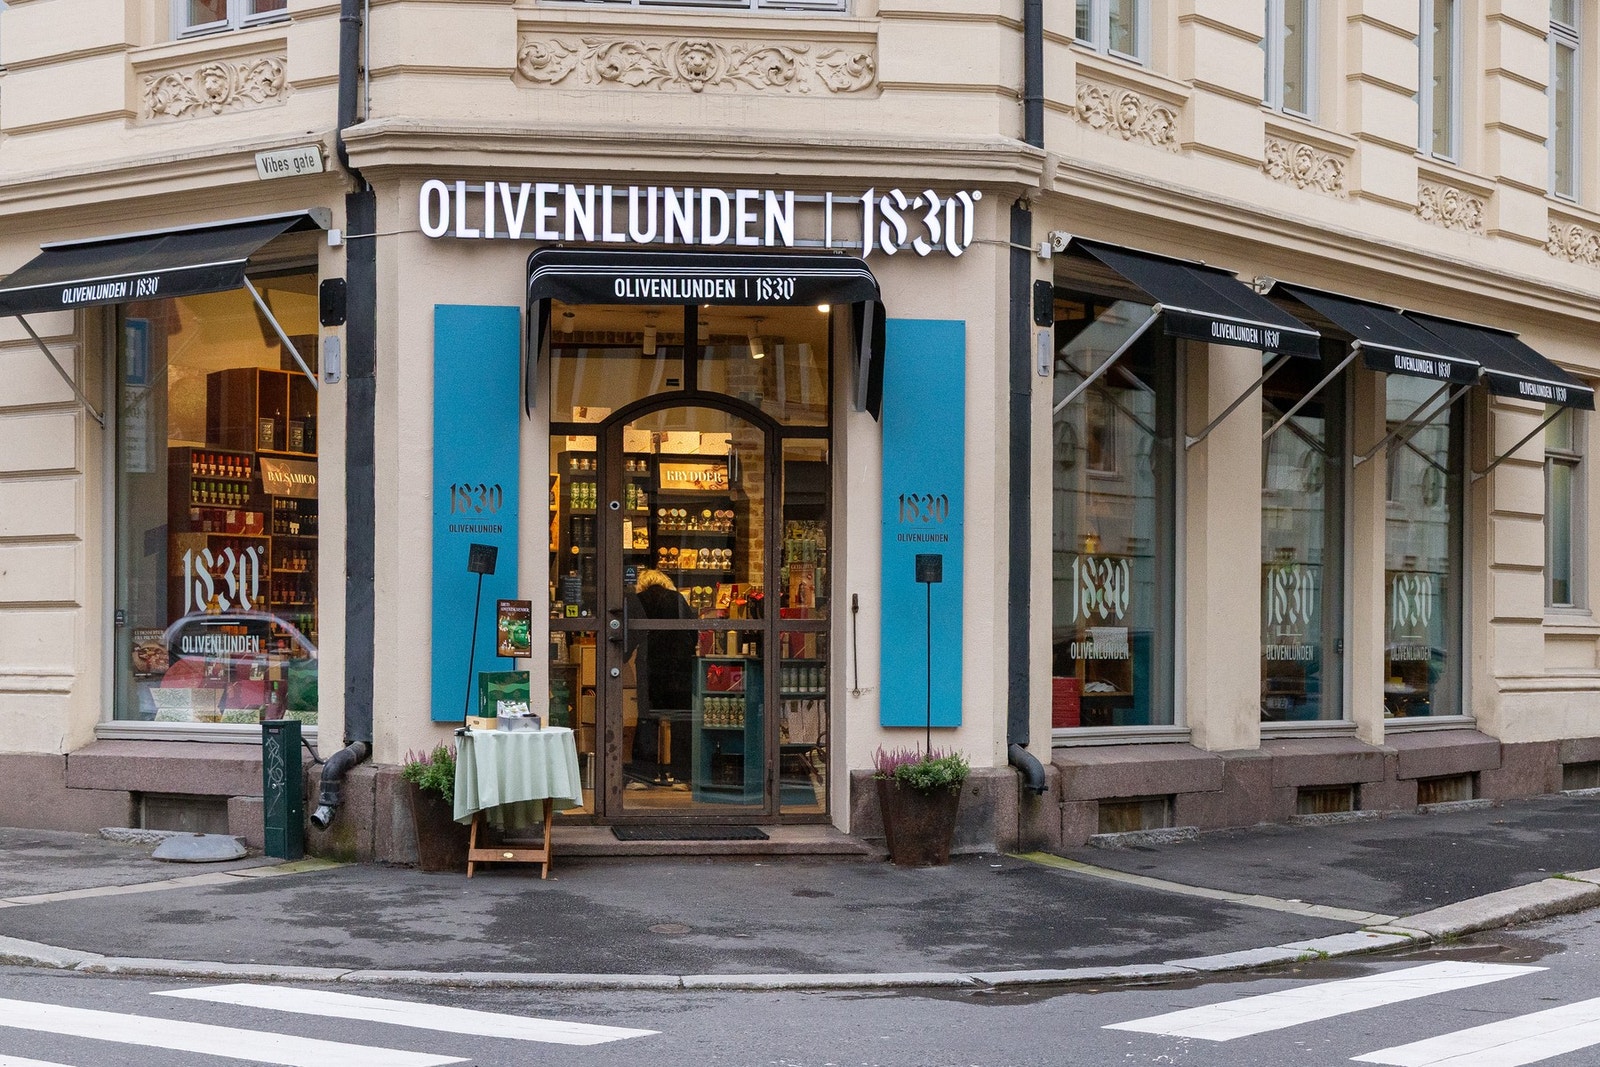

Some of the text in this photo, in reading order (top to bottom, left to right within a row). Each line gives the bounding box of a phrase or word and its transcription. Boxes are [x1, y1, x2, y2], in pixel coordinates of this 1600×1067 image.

[261, 153, 315, 174] Vibes gate
[418, 179, 795, 247] OLIVENLUNDEN
[62, 281, 127, 304] OLIVENLUNDEN
[614, 277, 736, 299] OLIVENLUNDEN
[1211, 321, 1259, 344] OLIVENLUNDEN
[1394, 354, 1434, 375] OLIVENLUNDEN
[1519, 381, 1553, 399] OLIVENLUNDEN
[267, 471, 316, 485] BALSAMICO
[666, 470, 722, 482] KRYDDER
[450, 482, 503, 515] 1830
[898, 492, 949, 524] 1830
[449, 523, 503, 534] OLIVENLUNDEN
[897, 533, 949, 543] OLIVENLUNDEN
[182, 635, 260, 654] OLIVENLUNDEN
[1070, 641, 1130, 660] OLIVENLUNDEN
[1266, 644, 1314, 661] OLIVENLUNDEN
